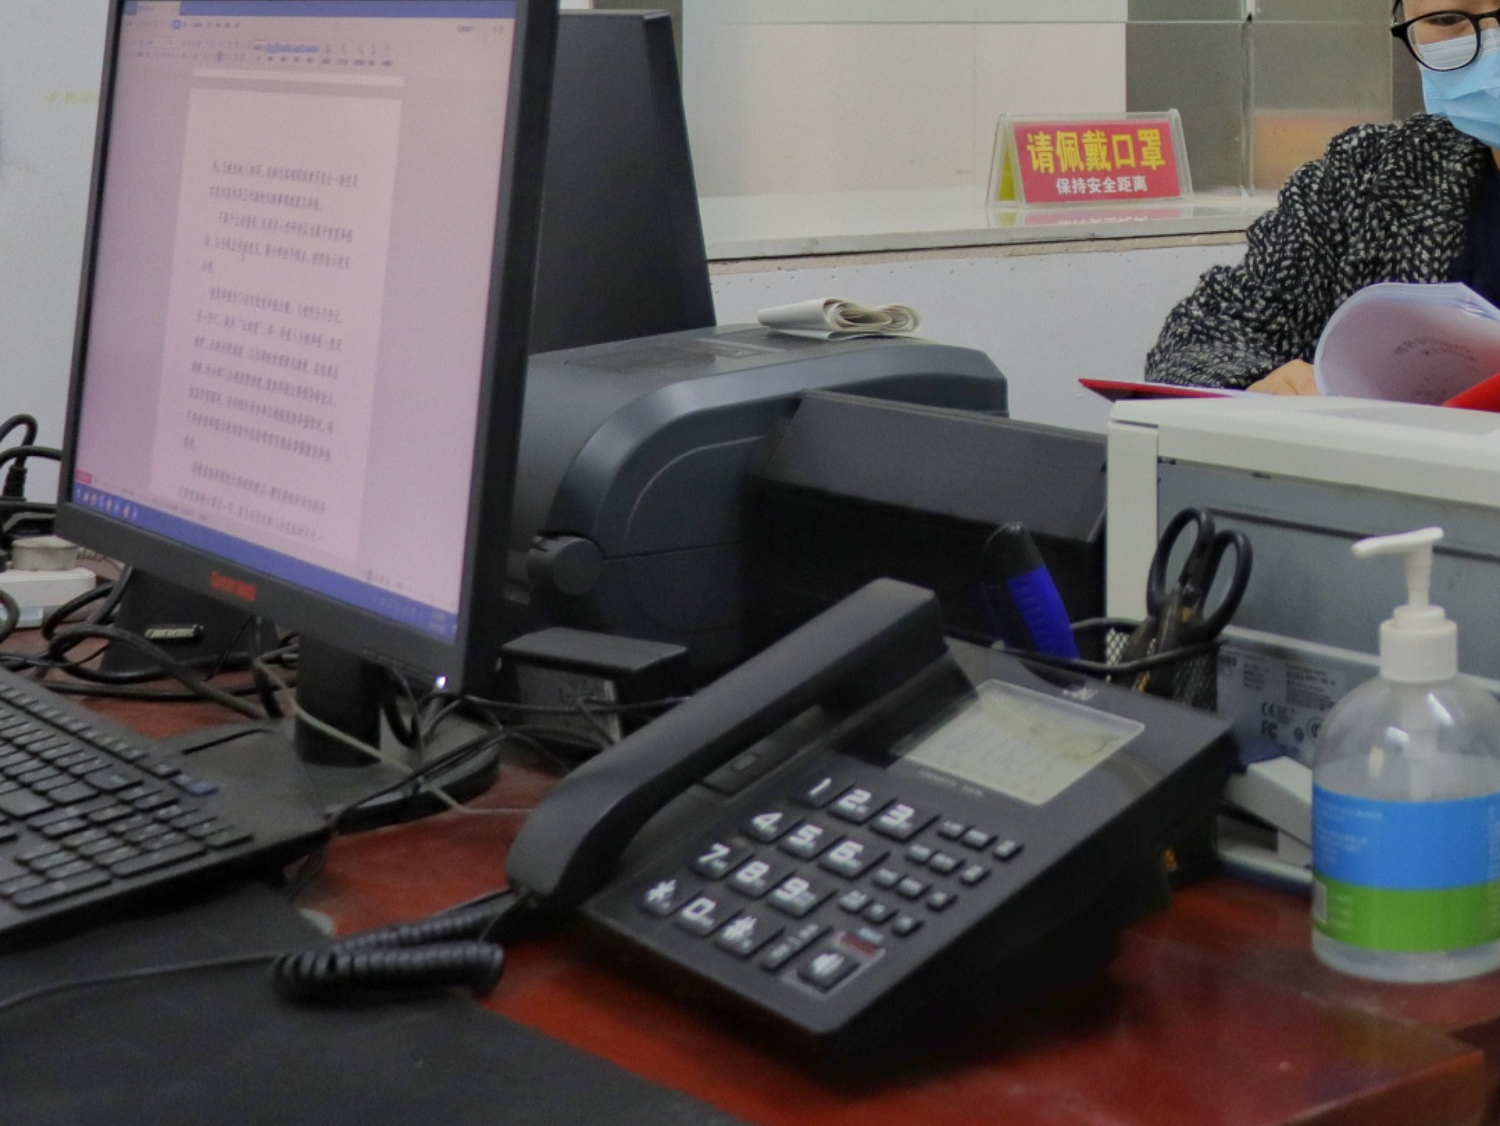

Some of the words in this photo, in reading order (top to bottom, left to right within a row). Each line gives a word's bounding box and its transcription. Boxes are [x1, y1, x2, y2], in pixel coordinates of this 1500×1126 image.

[1026, 128, 1167, 175] 请佩戴口罩
[1055, 175, 1148, 196] 保持安全距离
[838, 788, 872, 811] 2
[879, 803, 915, 825] 3
[788, 824, 823, 847] 5
[828, 840, 864, 863] 6
[736, 860, 770, 883] 8
[772, 877, 810, 901] 9
